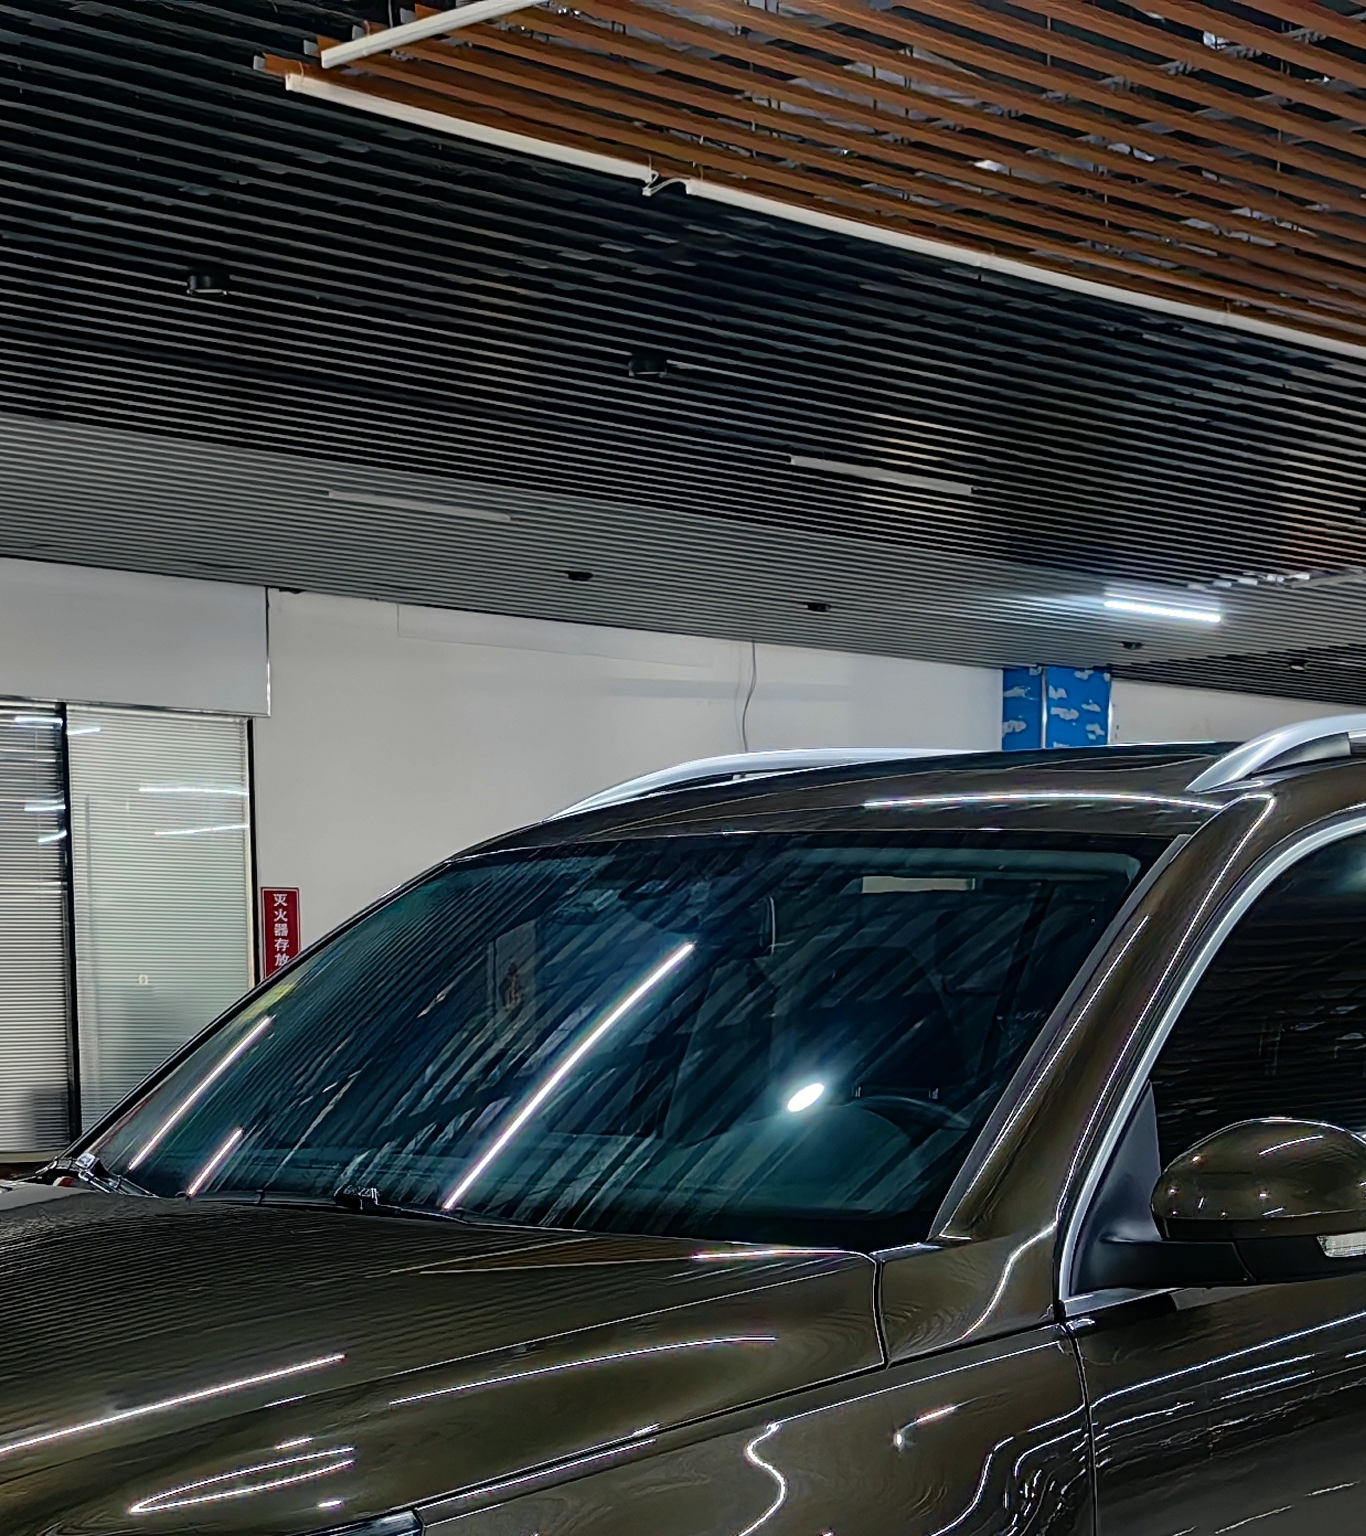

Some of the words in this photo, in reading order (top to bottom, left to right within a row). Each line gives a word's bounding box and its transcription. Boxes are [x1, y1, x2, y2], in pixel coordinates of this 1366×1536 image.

[273, 893, 290, 967] 灭火器存放
